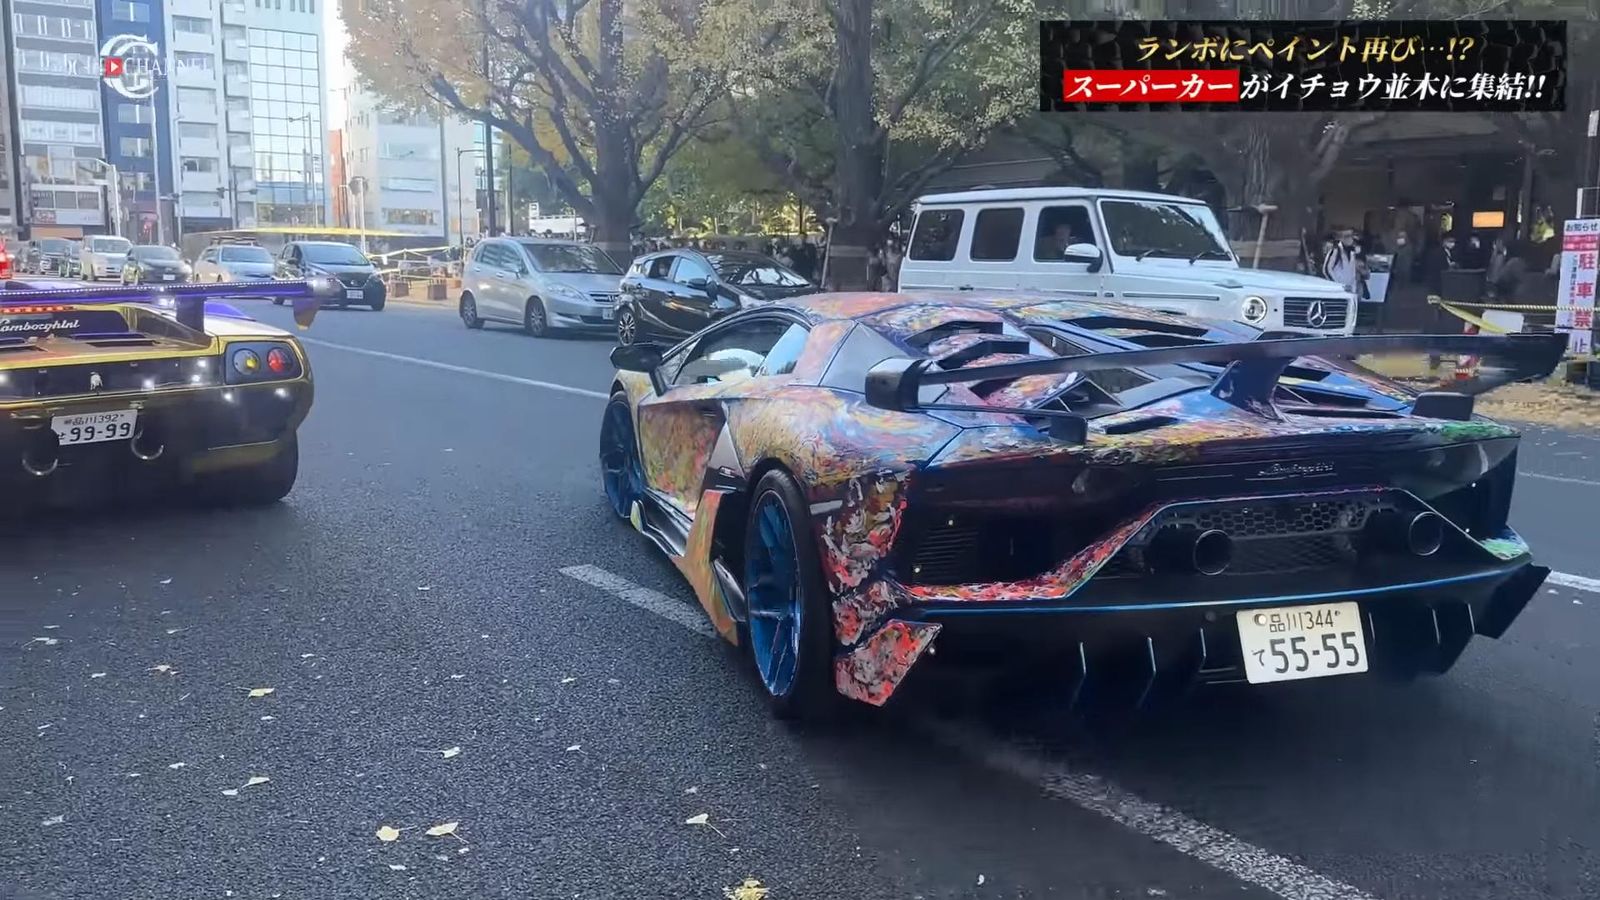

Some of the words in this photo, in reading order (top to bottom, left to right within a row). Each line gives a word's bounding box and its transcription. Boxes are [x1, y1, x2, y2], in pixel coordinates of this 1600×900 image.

[1572, 253, 1595, 354] 駐車禁止
[69, 422, 131, 442] 99-99
[1269, 609, 1334, 633] 品川344
[1269, 631, 1360, 674] 55-55
